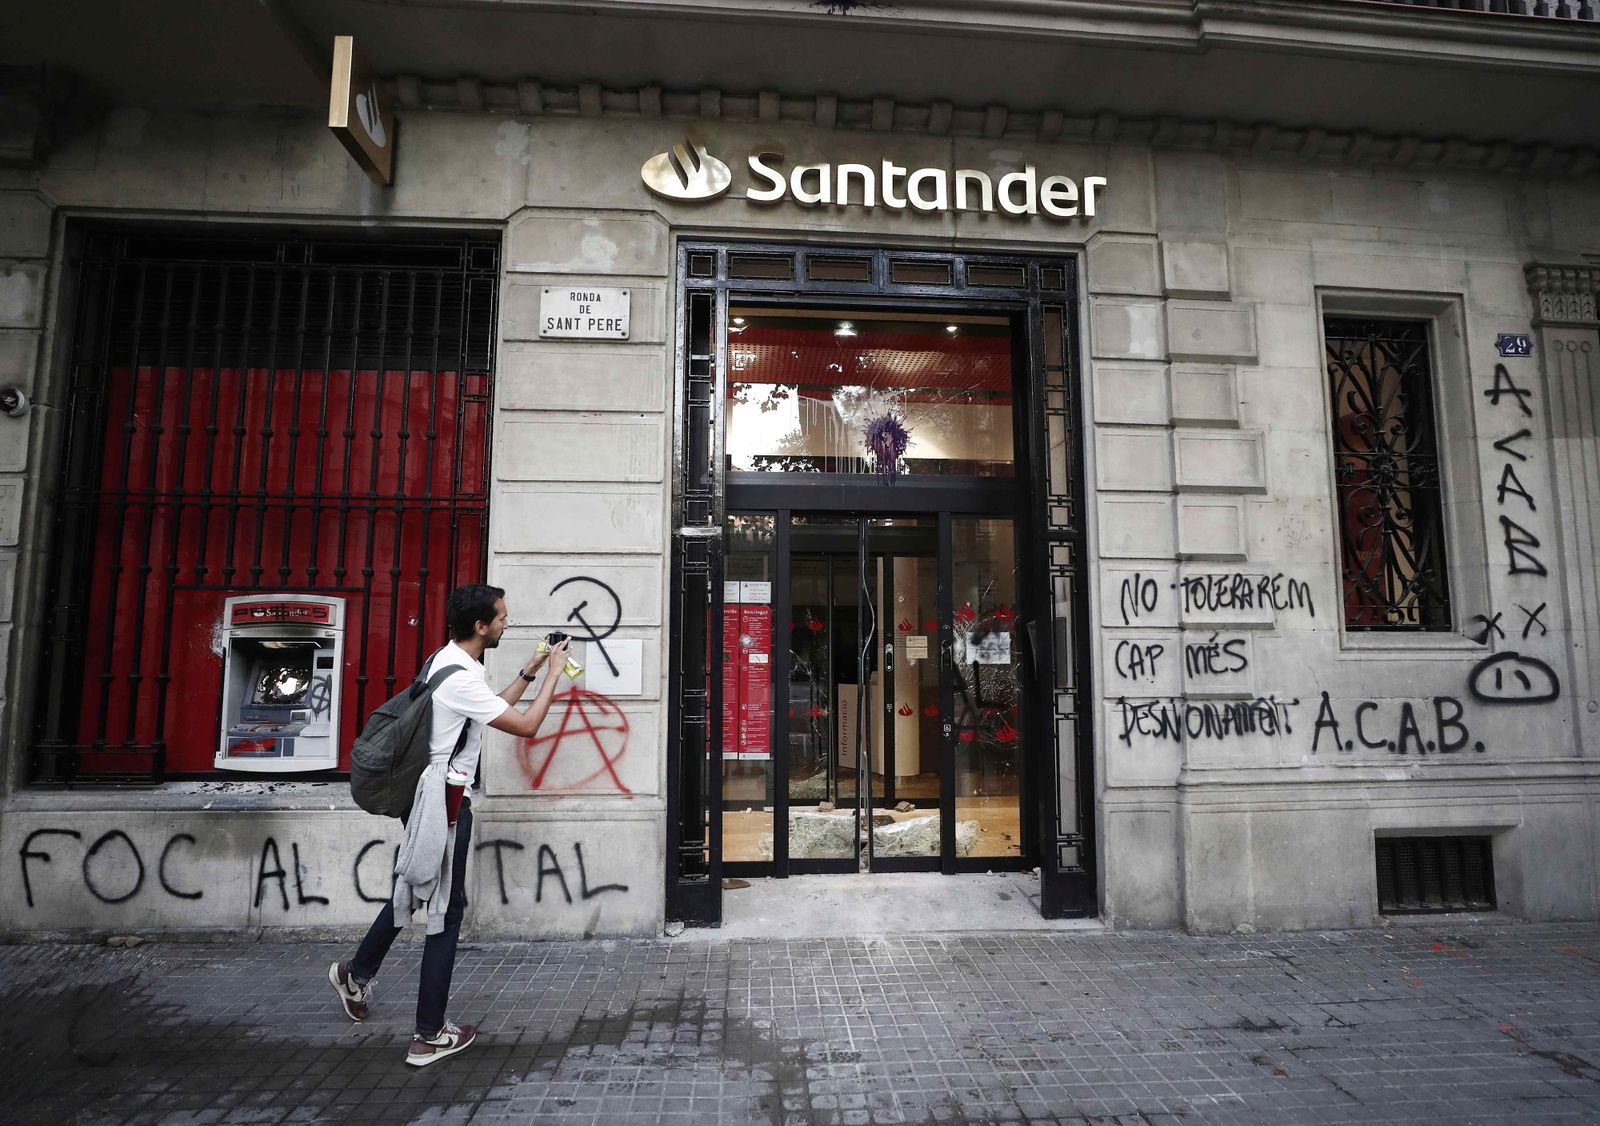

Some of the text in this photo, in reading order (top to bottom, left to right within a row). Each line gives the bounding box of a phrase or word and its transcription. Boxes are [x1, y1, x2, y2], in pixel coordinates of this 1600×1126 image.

[746, 151, 1107, 218] Santander
[570, 292, 602, 302] RONDA
[579, 304, 592, 315] DE
[547, 317, 623, 332] SANT PERE
[1504, 336, 1528, 354] 29
[1120, 572, 1315, 626] NO TOLERAREM
[1115, 632, 1248, 680] CAP MÉS
[1312, 690, 1486, 755] A.C.A.B.
[19, 828, 630, 911] FOC AL CTAL
